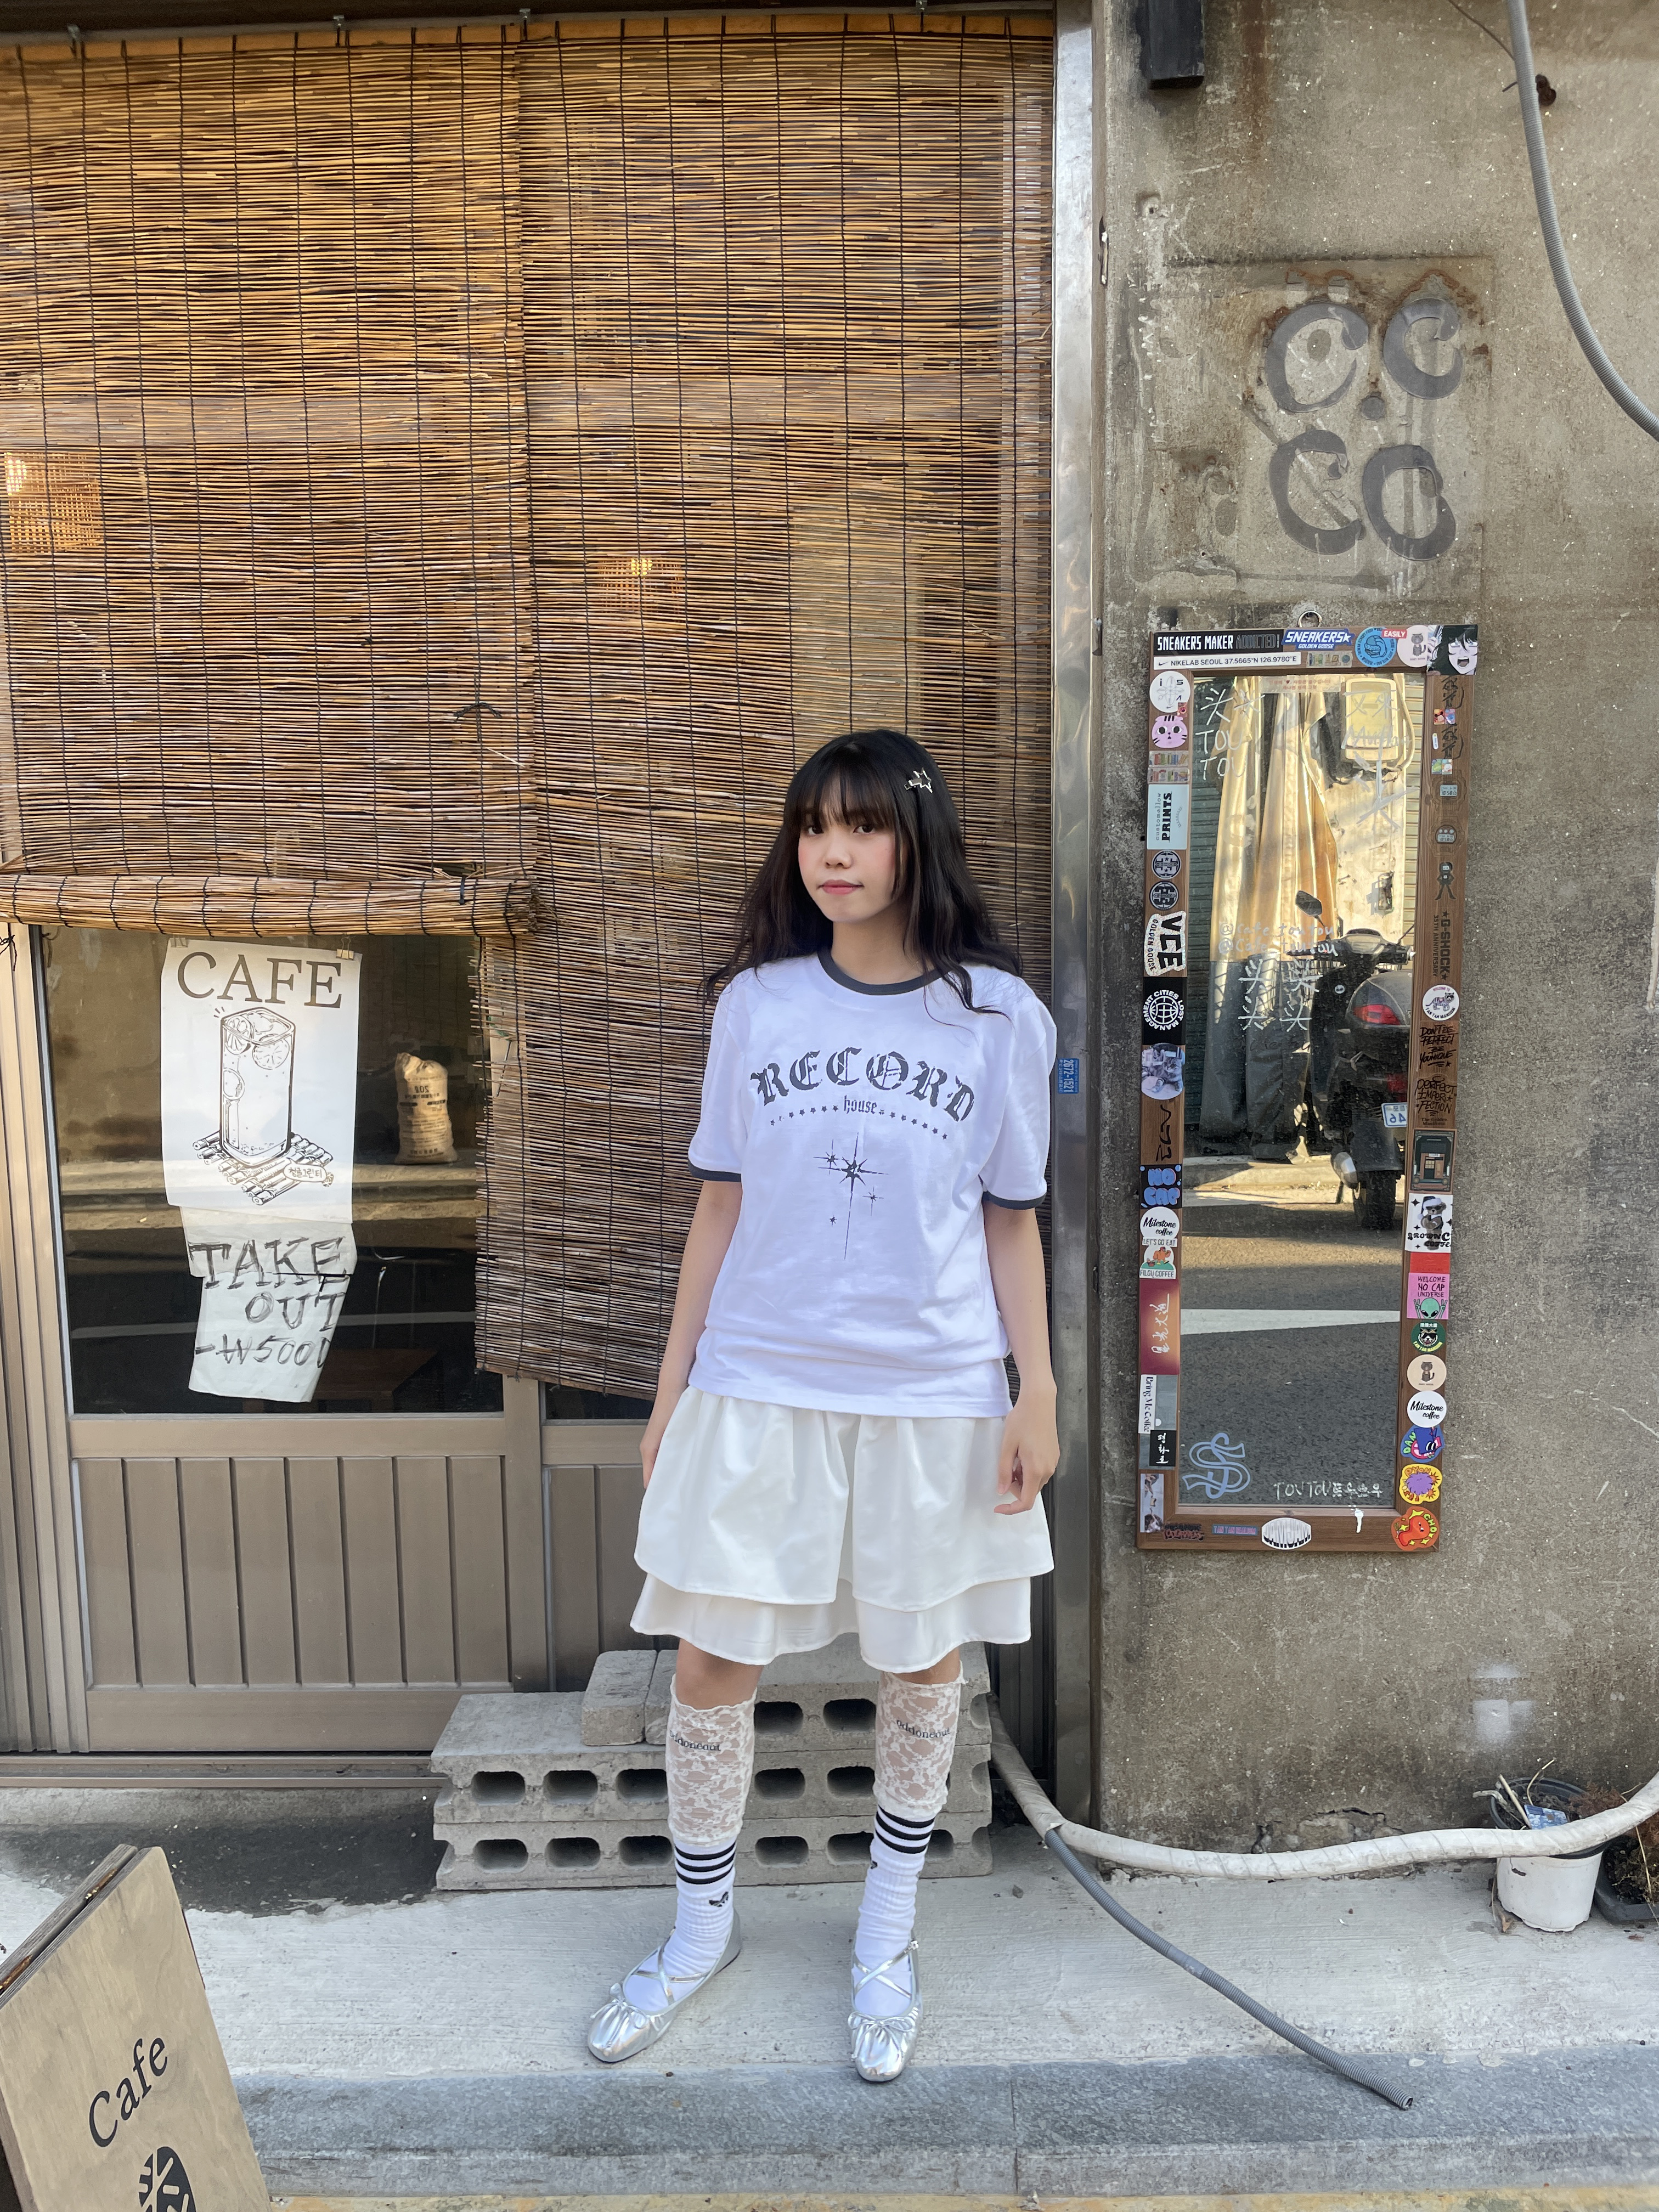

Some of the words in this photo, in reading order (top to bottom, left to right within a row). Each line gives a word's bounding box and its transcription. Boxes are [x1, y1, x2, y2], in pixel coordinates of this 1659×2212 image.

[1157, 635, 1201, 651] SNEAKERS
[1204, 635, 1234, 650] MAKER
[1284, 631, 1345, 643] SNEAKERS
[1195, 730, 1243, 754] TOU
[1200, 756, 1247, 780] TOU
[1161, 793, 1172, 842] PRINTS
[1147, 919, 1159, 946] GOLDEN
[1156, 915, 1183, 970] VCE
[1440, 919, 1451, 974] G-SHOCK
[1147, 948, 1157, 971] GOOSE
[177, 951, 342, 1009] CAFE
[1154, 990, 1180, 1000] CITIES
[1143, 995, 1180, 1031] MANAGEMENT
[750, 1047, 975, 1122] RECORD
[1063, 1059, 1074, 1092] 2672-1521
[844, 1095, 877, 1115] house
[1143, 1217, 1176, 1229] Milestone
[1155, 1228, 1173, 1236] coffee
[188, 1237, 347, 1292] TAKE
[1431, 1283, 1445, 1291] CAP
[245, 1291, 345, 1333] OUT
[1143, 1376, 1153, 1397] Bring
[1144, 1398, 1153, 1410] Me
[1410, 1401, 1444, 1412] Milestone
[1423, 1411, 1440, 1420] coffee
[896, 1718, 951, 1739] oddoneout
[89, 2037, 168, 2147] Cafe
